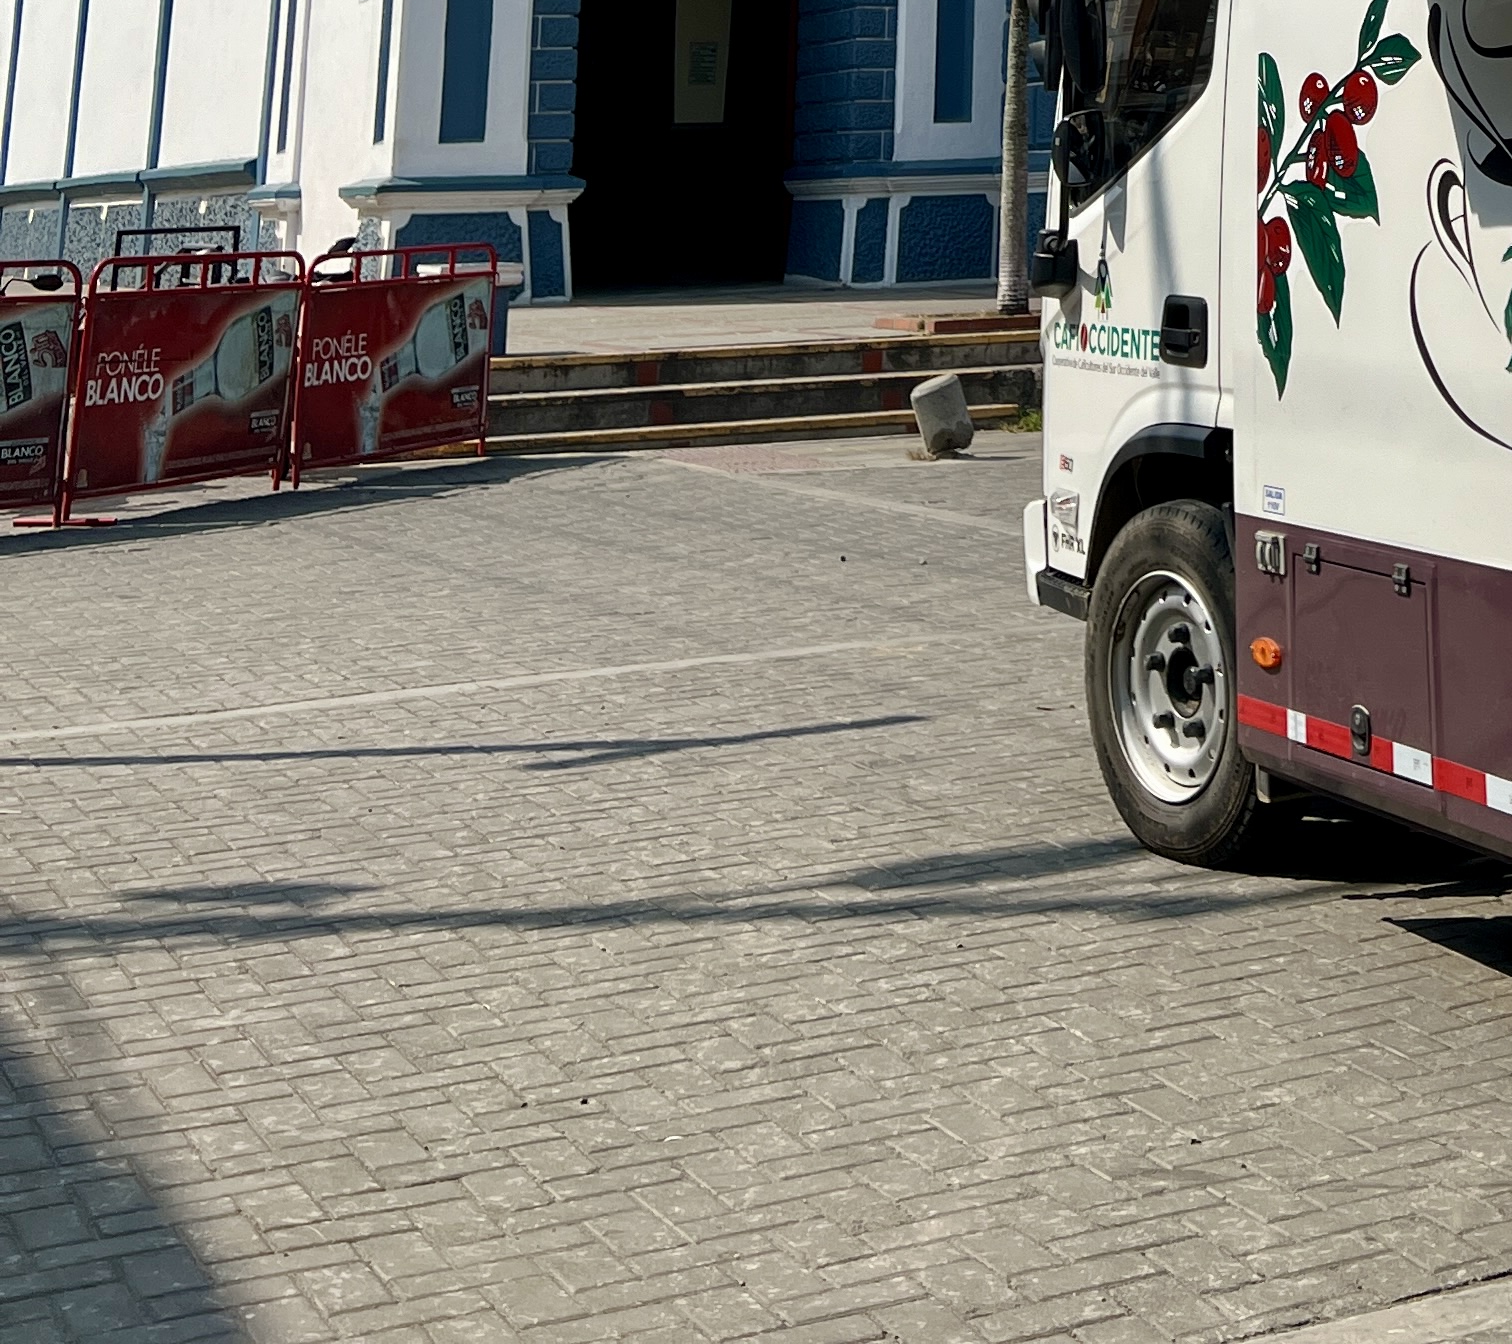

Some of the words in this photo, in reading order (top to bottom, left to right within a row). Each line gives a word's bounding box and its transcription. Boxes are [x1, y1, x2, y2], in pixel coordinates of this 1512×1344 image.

[312, 330, 368, 360] PONÉLE
[0, 329, 24, 405] BLANCO
[304, 355, 372, 387] BLANCO
[85, 373, 164, 407] BLANCO
[1, 445, 44, 459] BLANCO
